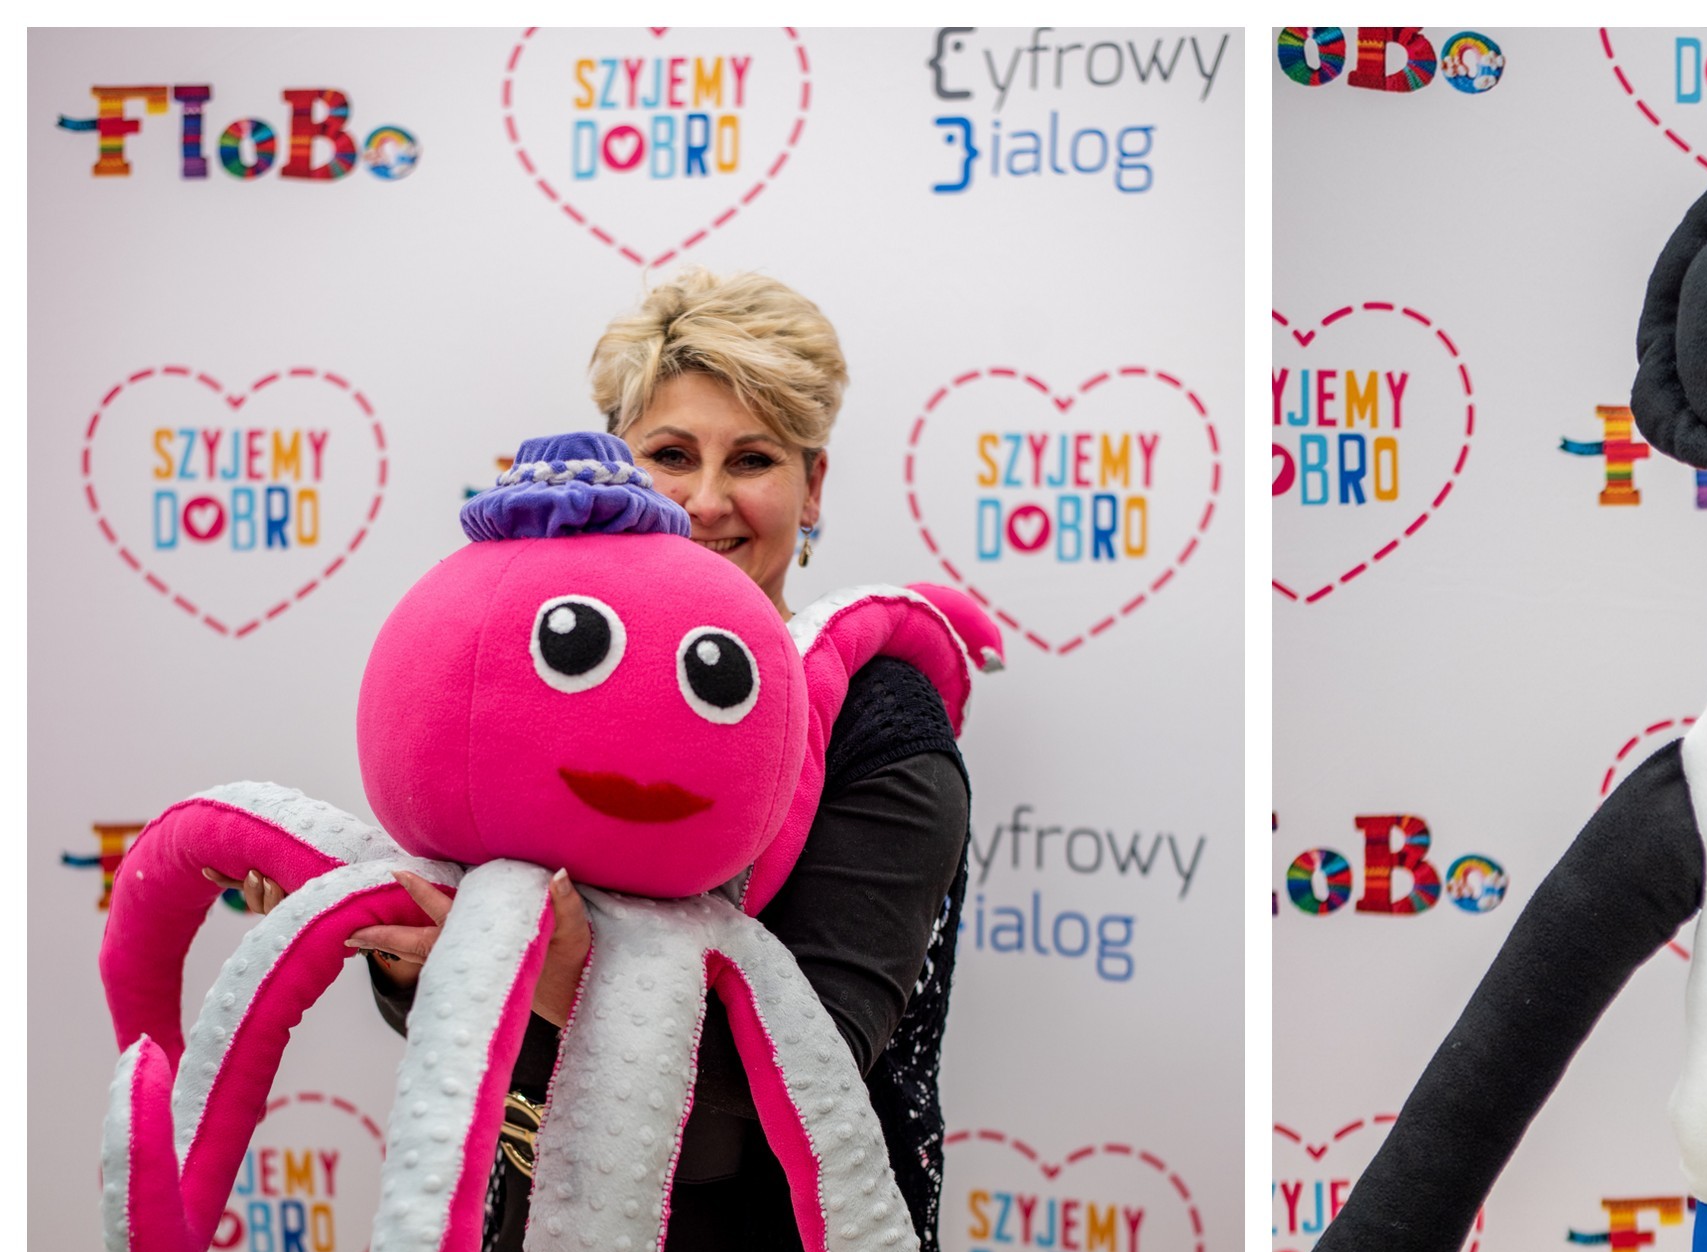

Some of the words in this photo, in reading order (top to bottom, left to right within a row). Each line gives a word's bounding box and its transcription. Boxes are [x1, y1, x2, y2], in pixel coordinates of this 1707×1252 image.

[573, 56, 752, 111] SZYJEMY
[927, 27, 1230, 108] Cyfrowy
[573, 112, 740, 180] DOBRO
[931, 112, 1156, 195] Dialog
[152, 428, 328, 482] SZYJEMY
[977, 432, 1160, 490] SZYJEMY
[153, 485, 320, 551] DOBRO
[976, 492, 1148, 563] DOBRO
[972, 805, 1205, 898] yfrowy
[1272, 810, 1509, 918] oBo
[976, 891, 1134, 982] ialog
[237, 1147, 338, 1197] JEMY
